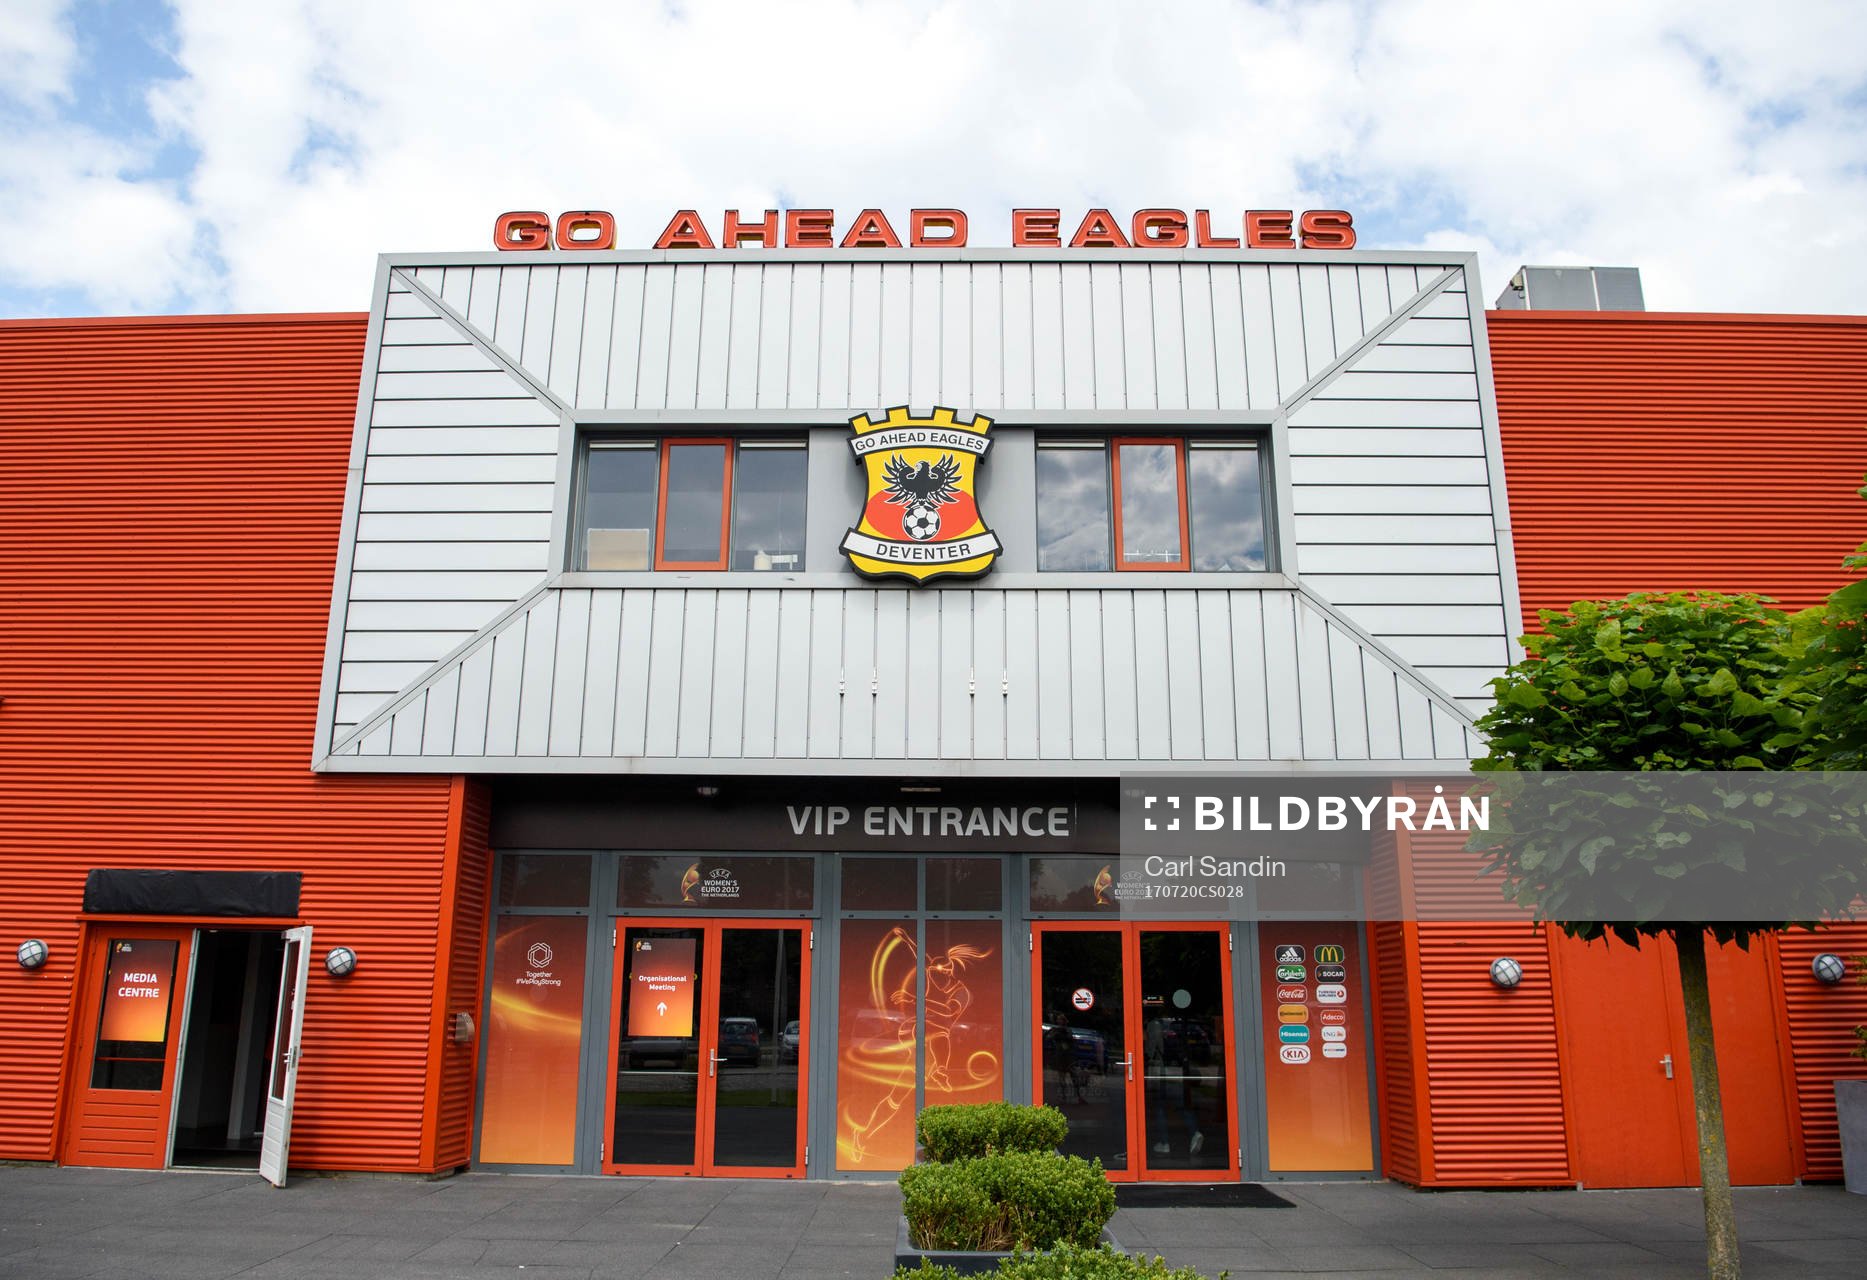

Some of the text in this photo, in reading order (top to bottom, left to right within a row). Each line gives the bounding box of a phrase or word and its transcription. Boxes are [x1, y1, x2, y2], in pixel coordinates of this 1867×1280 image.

[493, 208, 1357, 251] GO AHEAD EAGLES
[855, 432, 984, 451] GO AHEAD EAGLES
[876, 543, 971, 560] DEVENTER
[787, 805, 1069, 837] VIP ENTRANCE
[710, 870, 731, 879] UEFA
[124, 972, 158, 983] MEDIA
[638, 975, 687, 983] Organisational
[118, 987, 160, 998] CENTRE
[649, 984, 676, 992] Meeting
[1286, 1050, 1304, 1058] KIA
